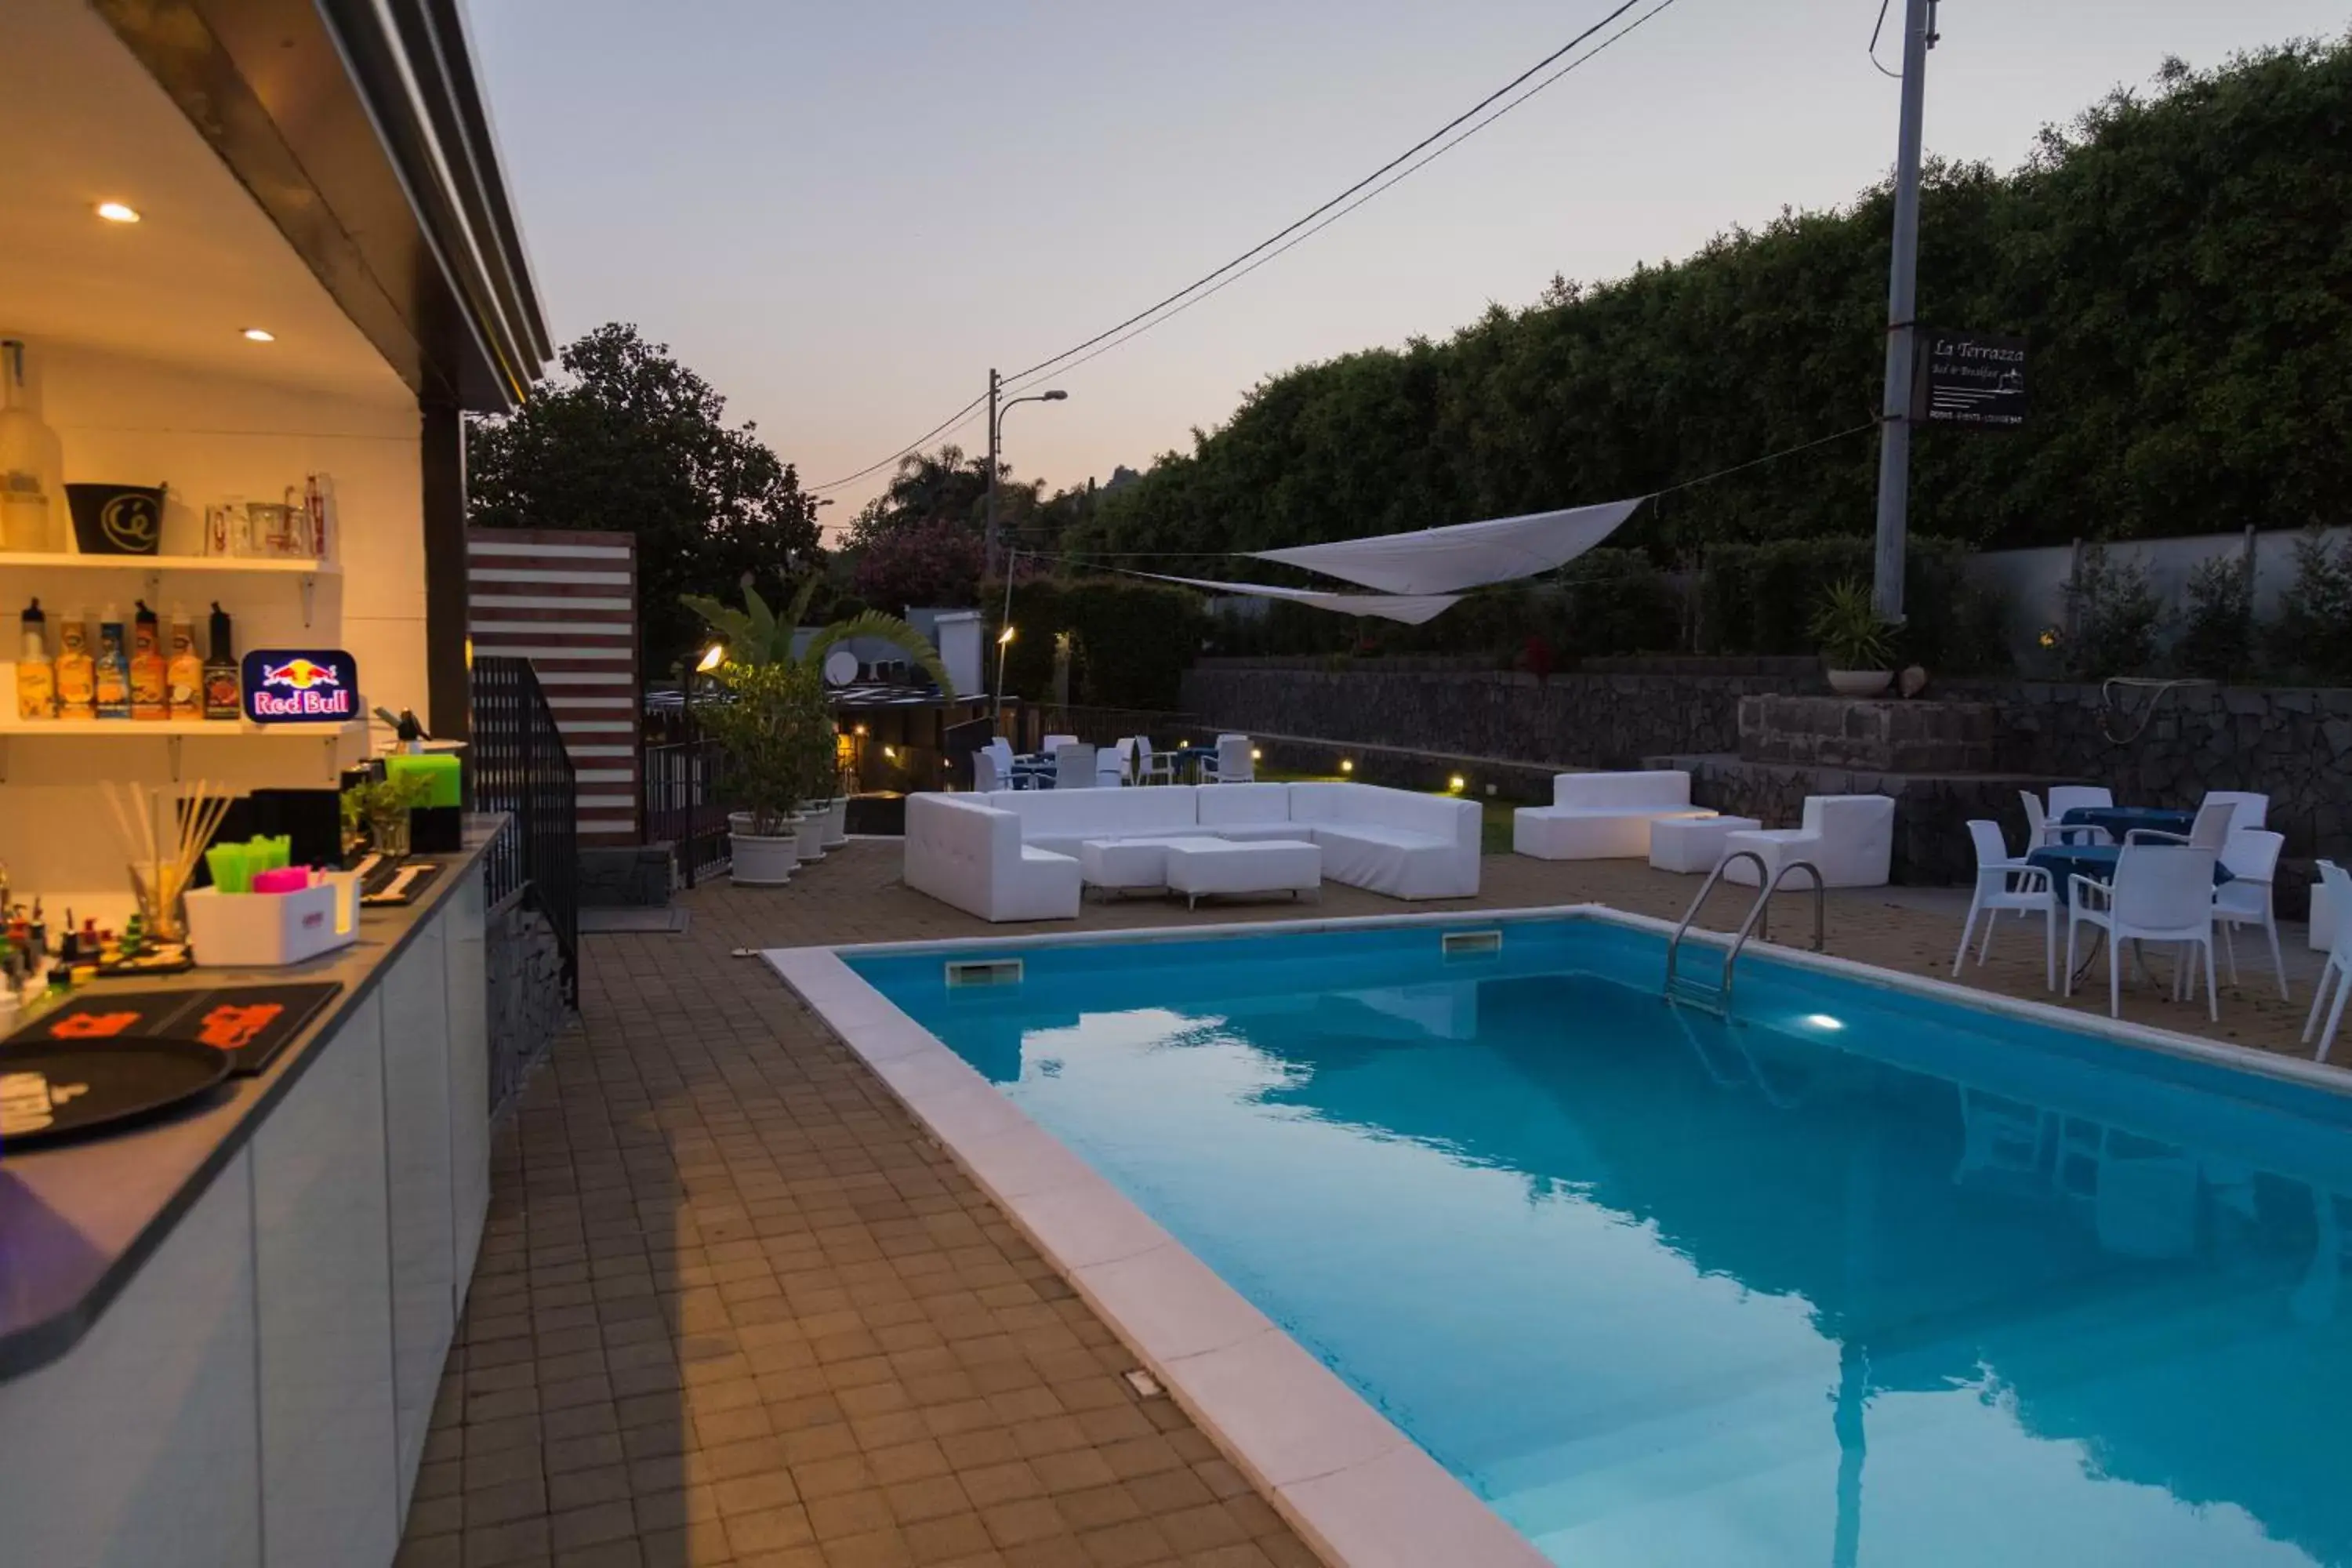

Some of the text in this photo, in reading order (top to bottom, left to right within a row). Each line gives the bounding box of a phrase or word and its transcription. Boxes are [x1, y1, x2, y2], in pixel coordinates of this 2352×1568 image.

[1934, 339, 2024, 362] La Terrazza
[254, 689, 350, 715] Red Bull
